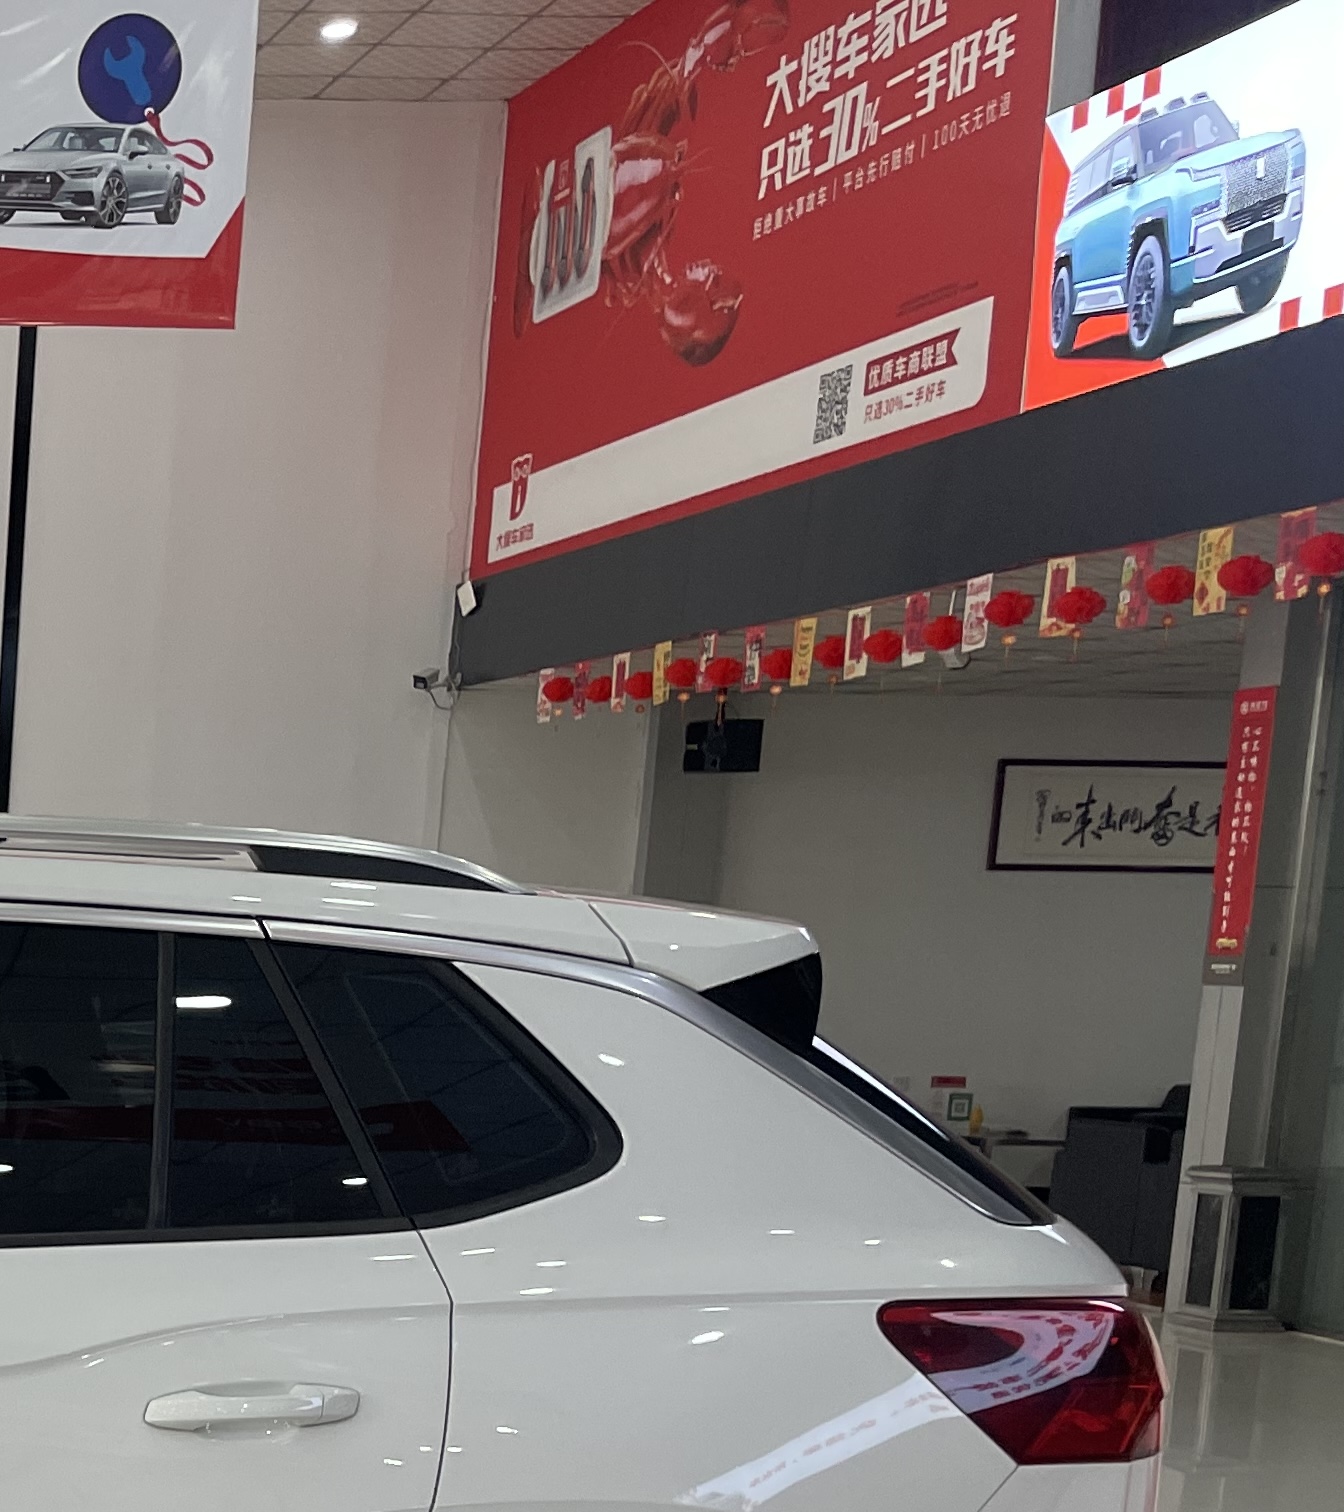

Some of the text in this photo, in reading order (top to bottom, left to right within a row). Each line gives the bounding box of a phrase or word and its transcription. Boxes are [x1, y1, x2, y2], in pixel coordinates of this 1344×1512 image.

[758, 14, 1018, 201] 只选30%二手好车
